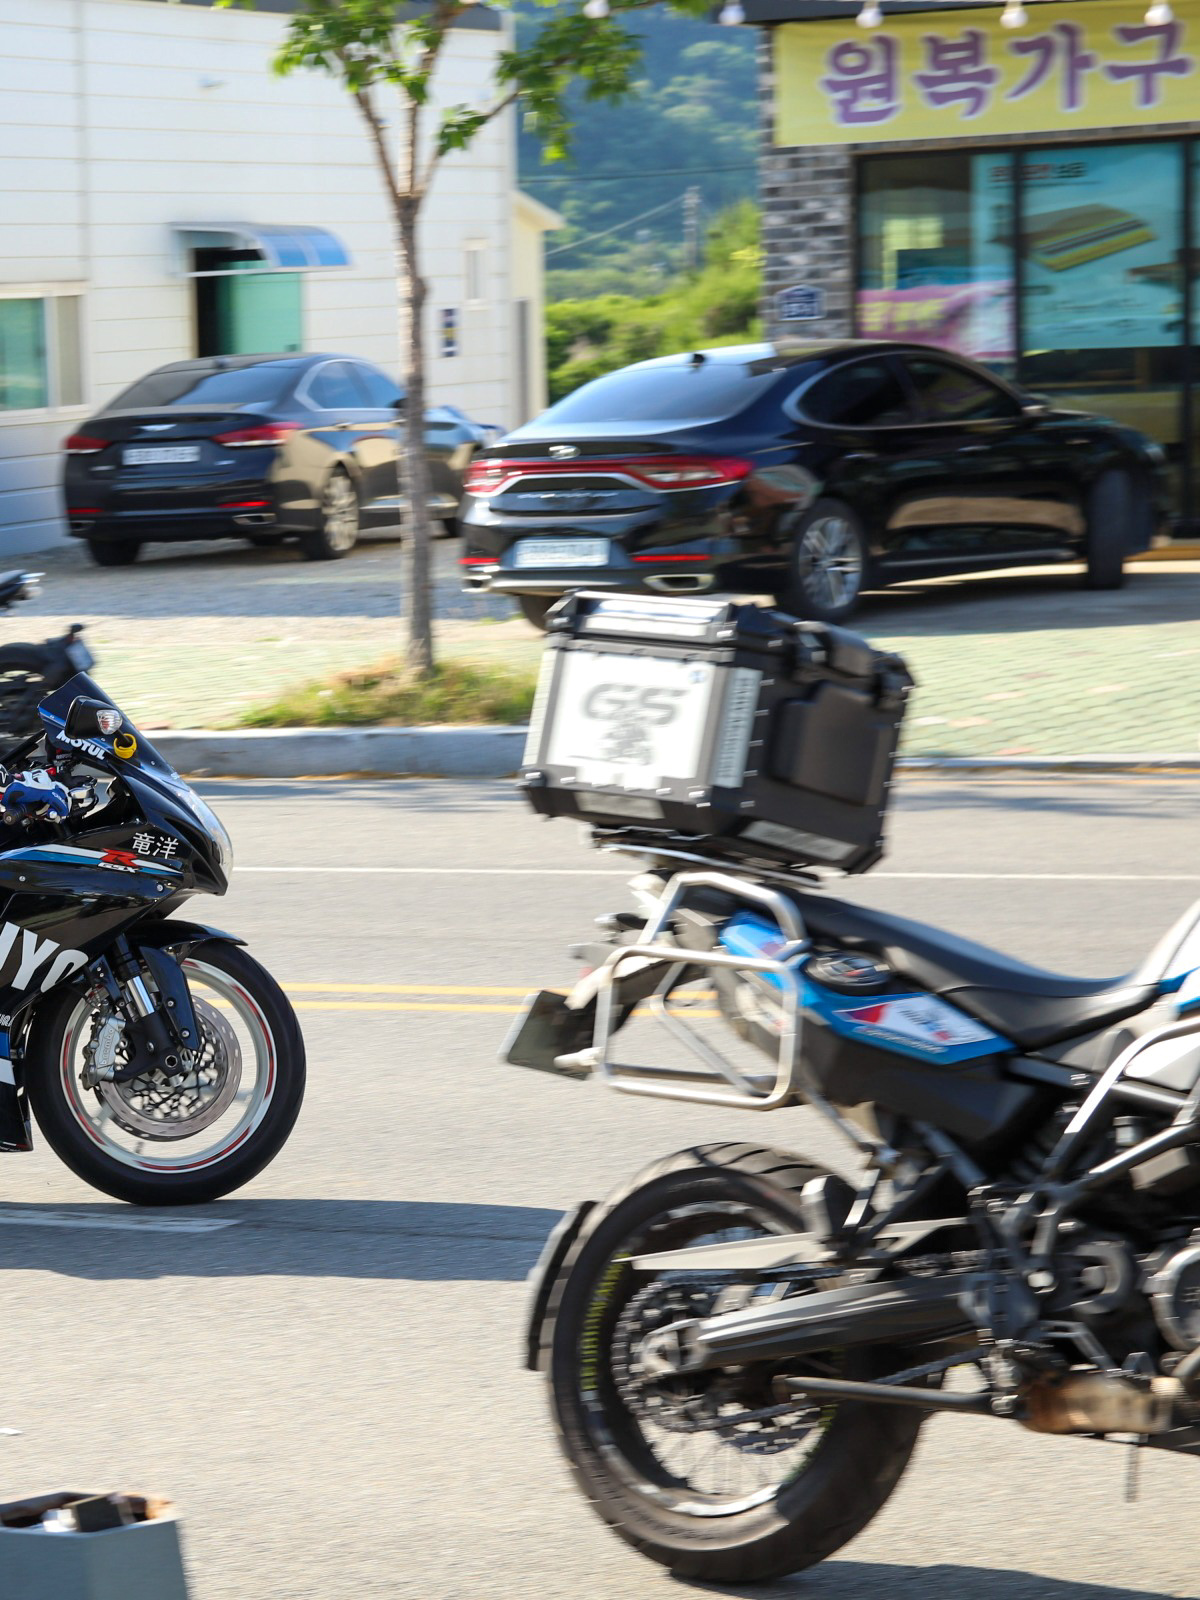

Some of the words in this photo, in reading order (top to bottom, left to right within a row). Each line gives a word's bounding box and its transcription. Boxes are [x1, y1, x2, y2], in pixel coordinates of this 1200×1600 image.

[821, 21, 1193, 126] 원복가구
[56, 730, 106, 760] MOTUL
[132, 833, 179, 859] 竜洋
